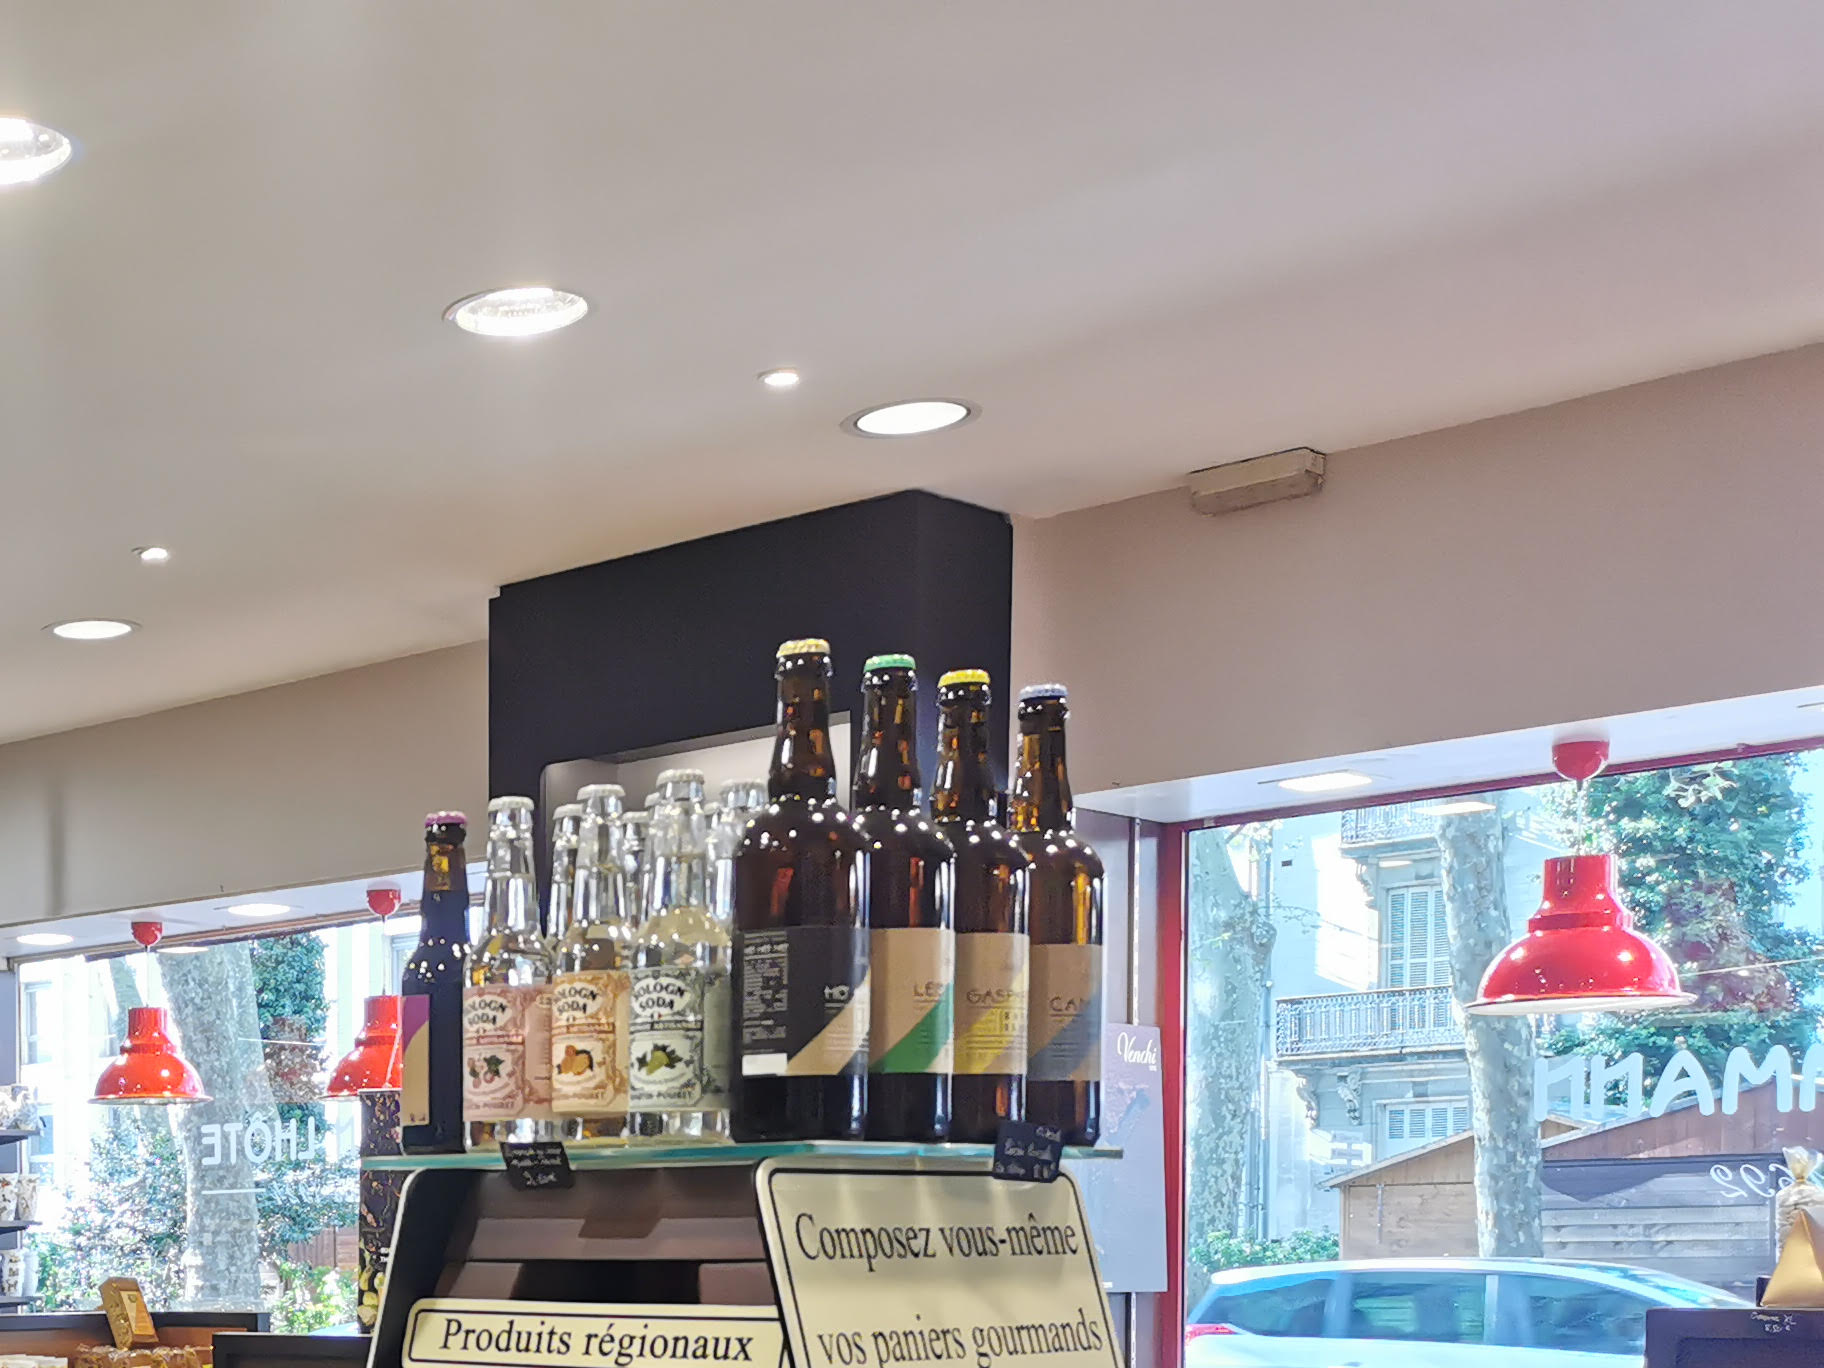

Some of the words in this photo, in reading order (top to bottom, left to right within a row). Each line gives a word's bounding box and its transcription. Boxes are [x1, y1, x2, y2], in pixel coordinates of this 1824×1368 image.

[1117, 1032, 1157, 1065] Venchi
[795, 1212, 937, 1272] Composez
[940, 1211, 1080, 1260] vous-même
[439, 1317, 572, 1359] Produits
[583, 1320, 754, 1367] régionaux
[817, 1330, 868, 1368] vos
